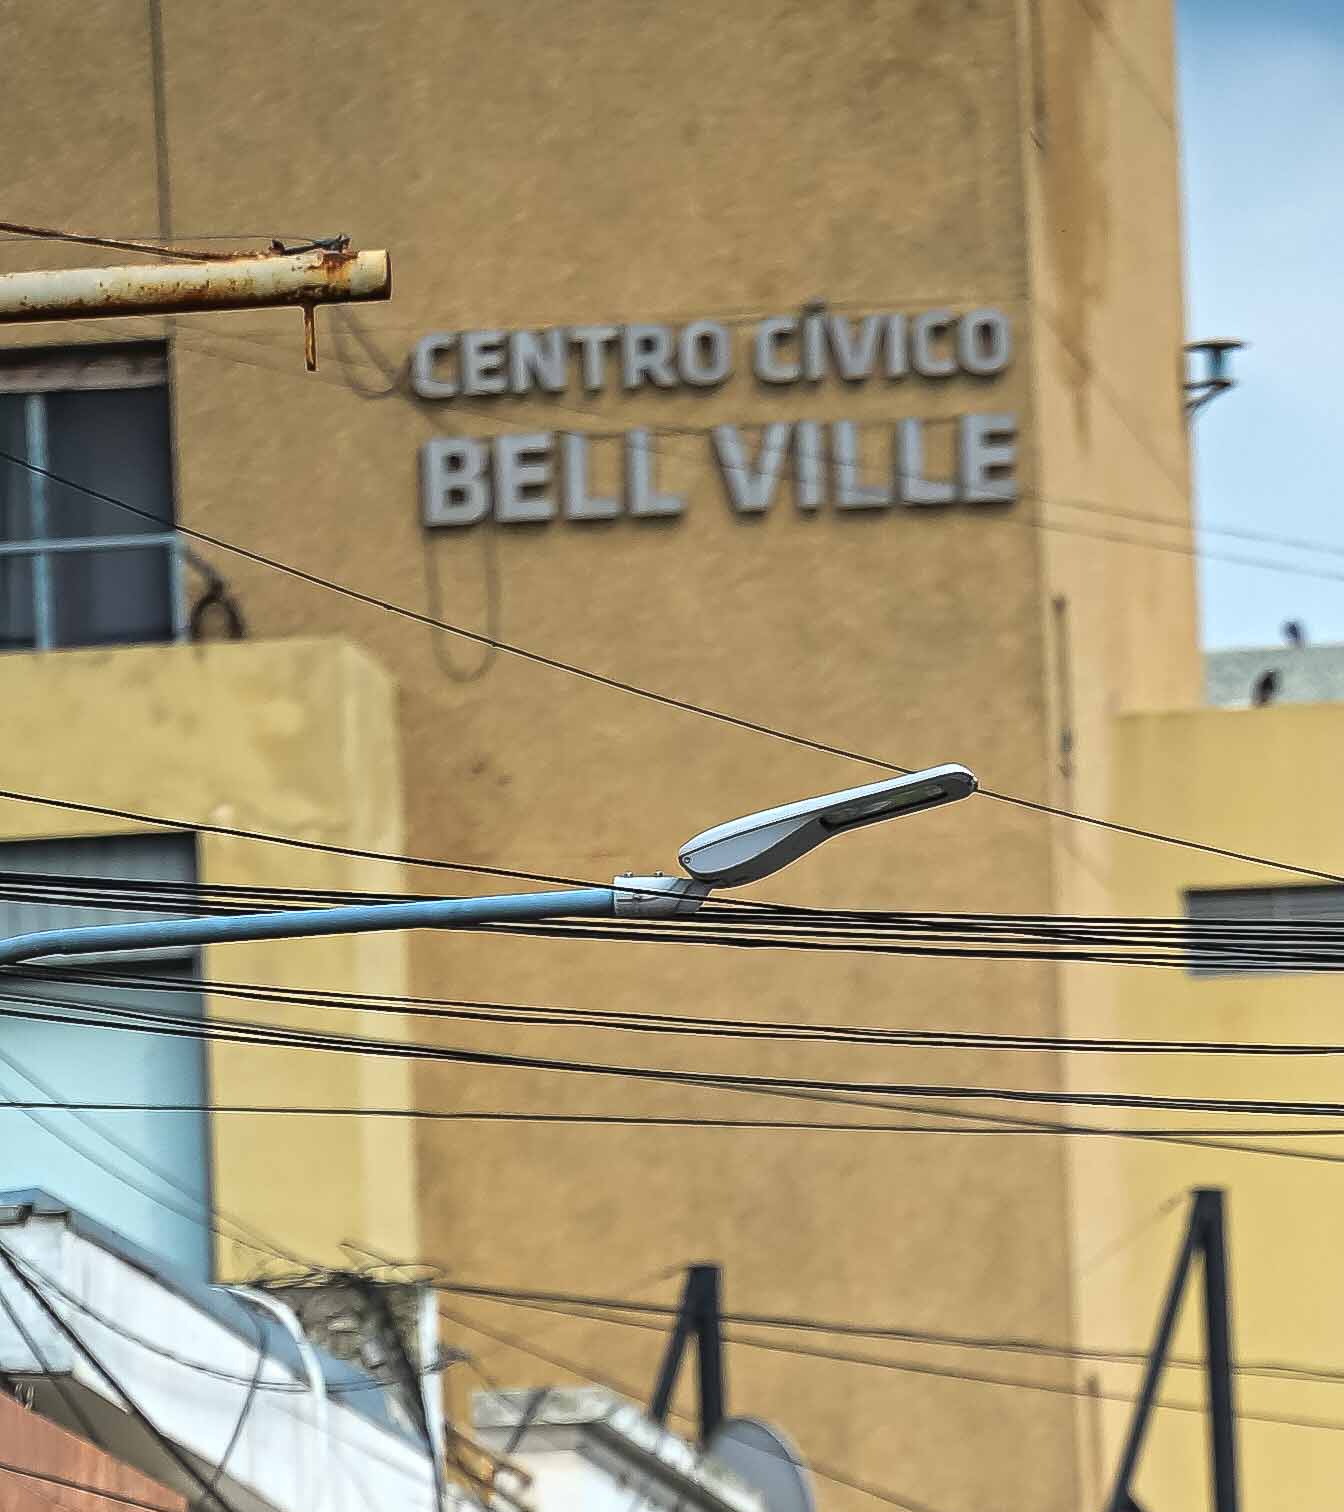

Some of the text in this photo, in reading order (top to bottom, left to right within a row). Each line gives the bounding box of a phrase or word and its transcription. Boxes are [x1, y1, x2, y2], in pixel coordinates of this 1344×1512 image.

[412, 299, 1015, 399] CENTRO CÍVICO
[421, 410, 1020, 528] BELL VILLE
